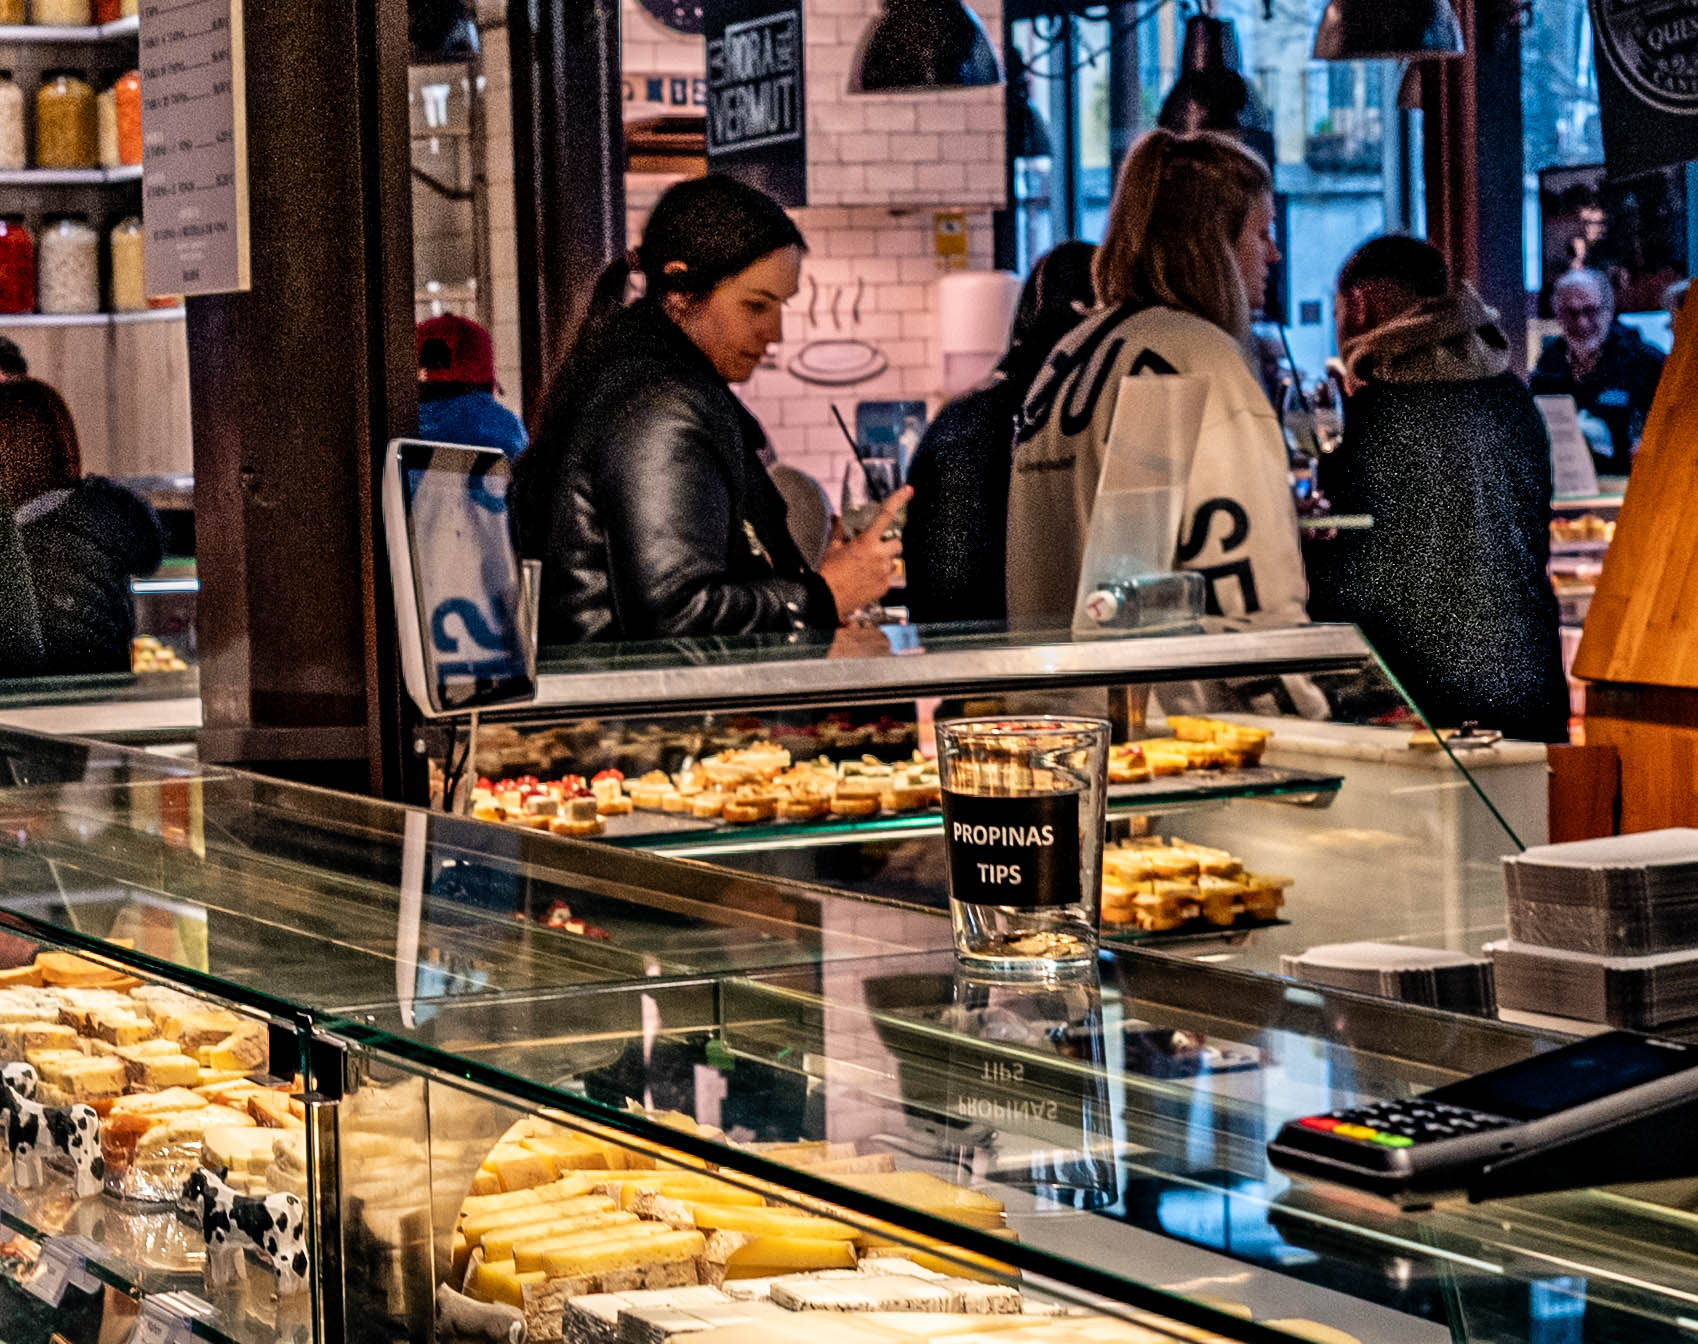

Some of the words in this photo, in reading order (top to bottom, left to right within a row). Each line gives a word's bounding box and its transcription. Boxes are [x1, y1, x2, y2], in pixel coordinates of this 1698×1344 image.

[711, 75, 794, 144] VERMUT
[953, 820, 1055, 848] PROPINAS
[976, 862, 1022, 886] TIPS
